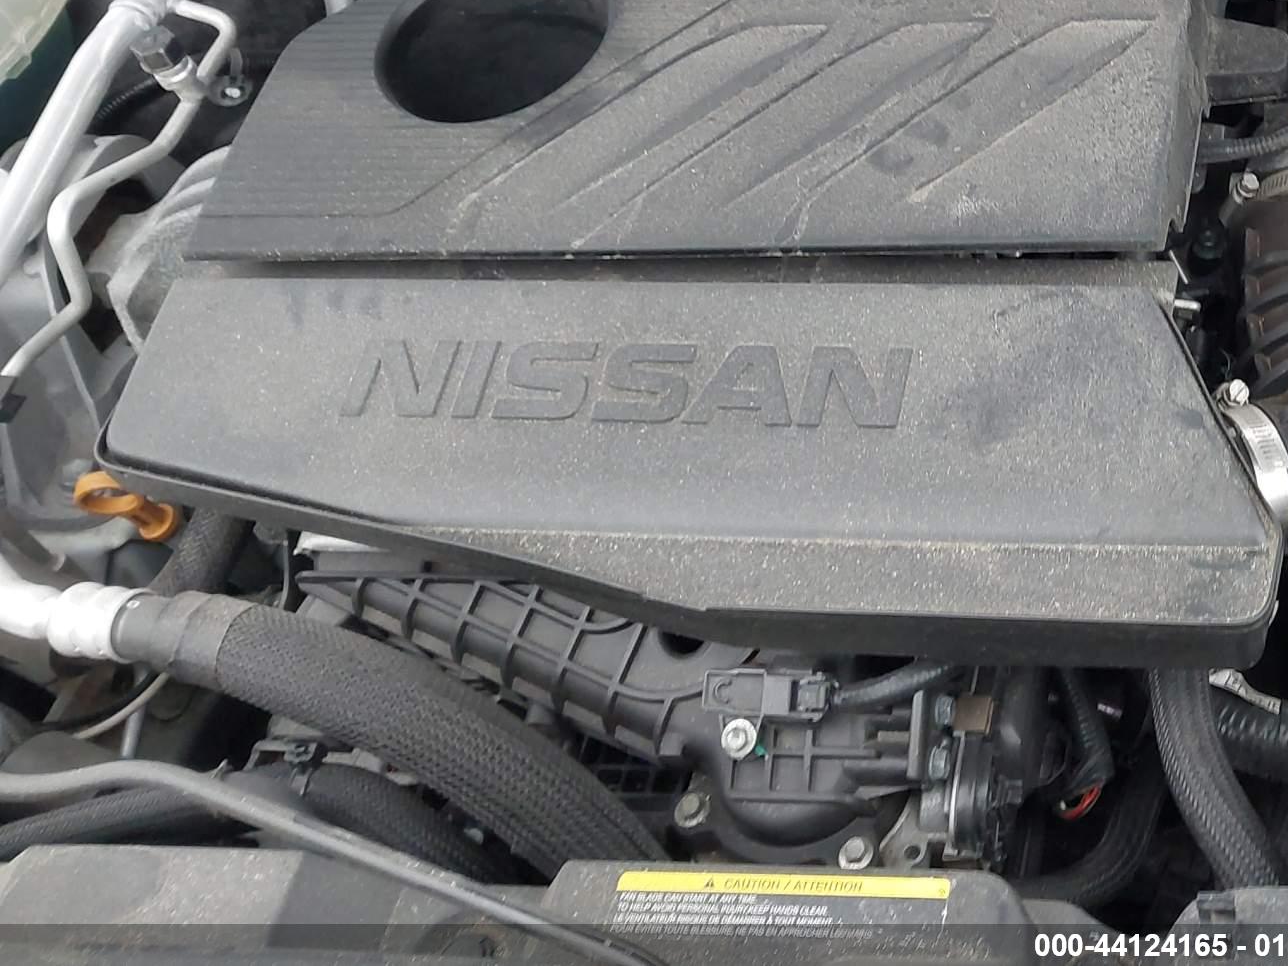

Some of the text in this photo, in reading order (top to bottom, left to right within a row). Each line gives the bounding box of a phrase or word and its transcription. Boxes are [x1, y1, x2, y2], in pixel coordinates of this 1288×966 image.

[339, 339, 914, 429] NISSAN
[724, 879, 780, 891] CAUTION
[793, 881, 863, 892] ATTENTION
